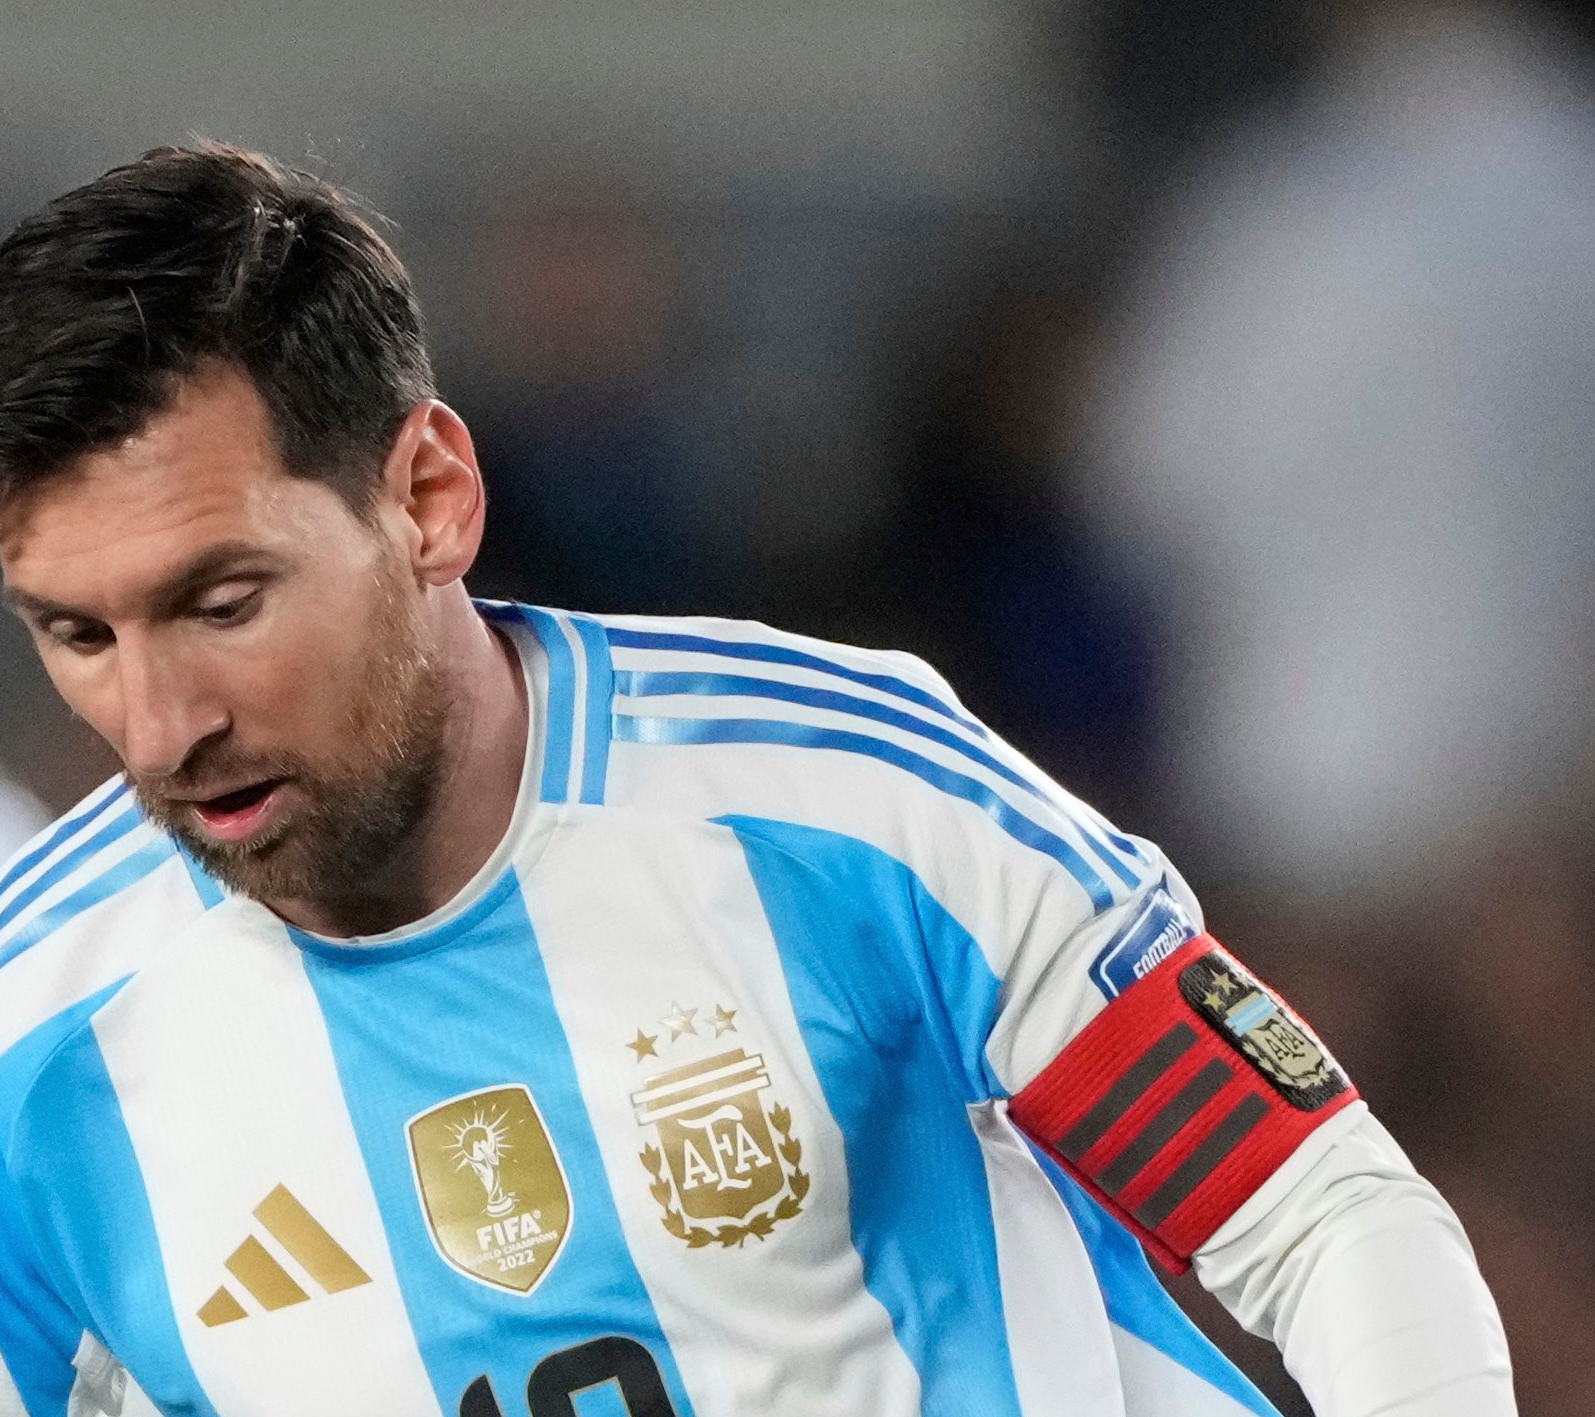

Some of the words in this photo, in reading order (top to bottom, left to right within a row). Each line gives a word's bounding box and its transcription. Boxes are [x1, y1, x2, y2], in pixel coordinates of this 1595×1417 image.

[1254, 1018, 1306, 1061] AFA
[676, 1104, 772, 1191] AFA
[476, 1212, 542, 1251] FIFA
[503, 1230, 558, 1256] CHAMPIONS
[496, 1249, 536, 1273] 2022
